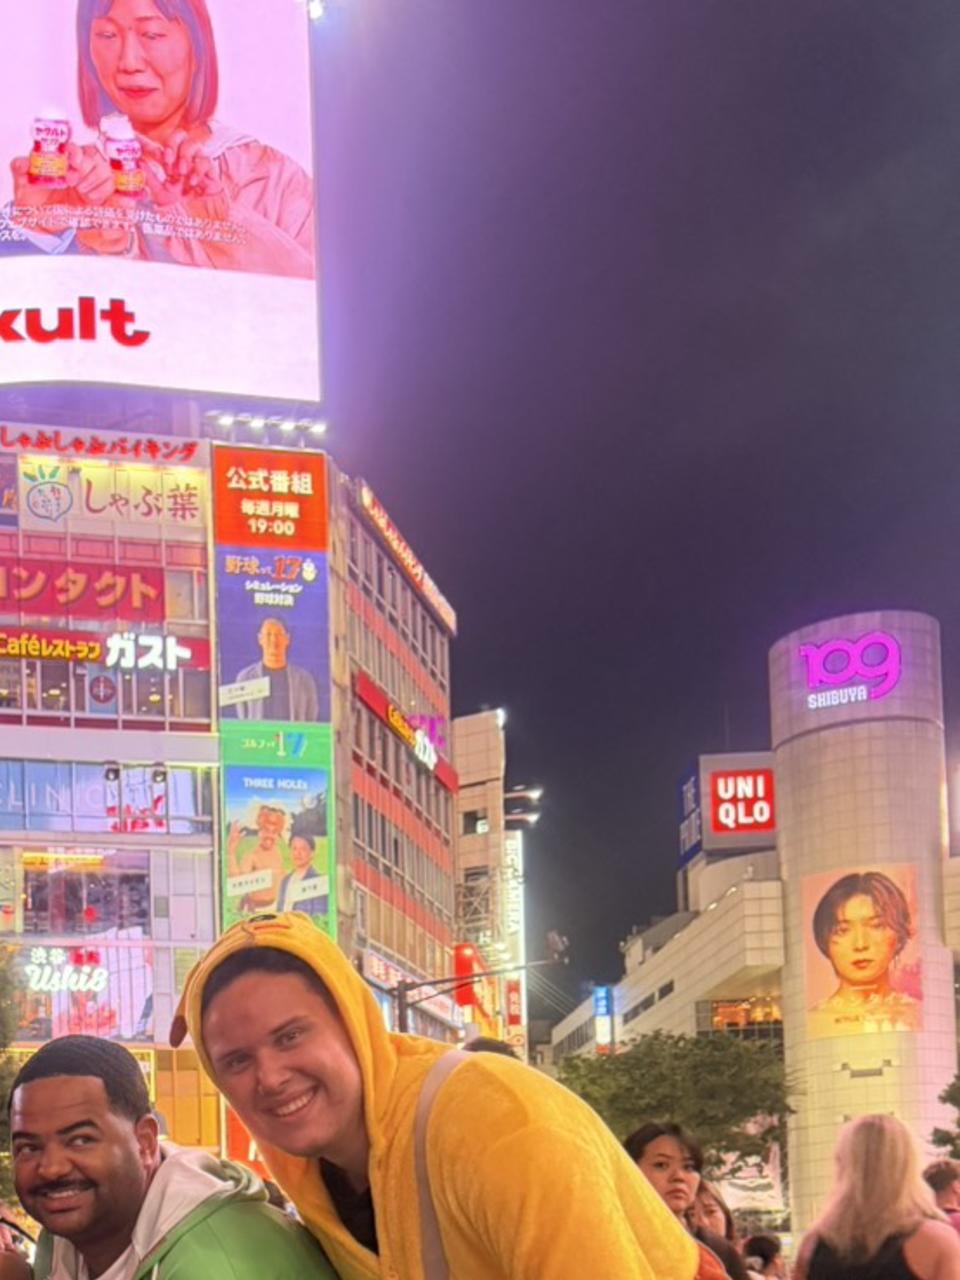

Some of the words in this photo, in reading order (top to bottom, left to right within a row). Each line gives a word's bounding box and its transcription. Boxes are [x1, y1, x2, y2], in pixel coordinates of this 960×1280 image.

[0, 426, 199, 462] しゃぶしゃぶバイキング
[226, 466, 314, 495] 公式番組
[84, 479, 200, 520] しゃぶ葉
[240, 498, 300, 519] 毎週月曜
[247, 518, 295, 536] 19:00
[105, 632, 192, 671] ガスト
[798, 630, 902, 701] 109
[807, 685, 868, 709] SHIBUYA
[243, 777, 276, 790] THREE
[717, 774, 765, 800] UNI
[718, 800, 771, 829] QLO
